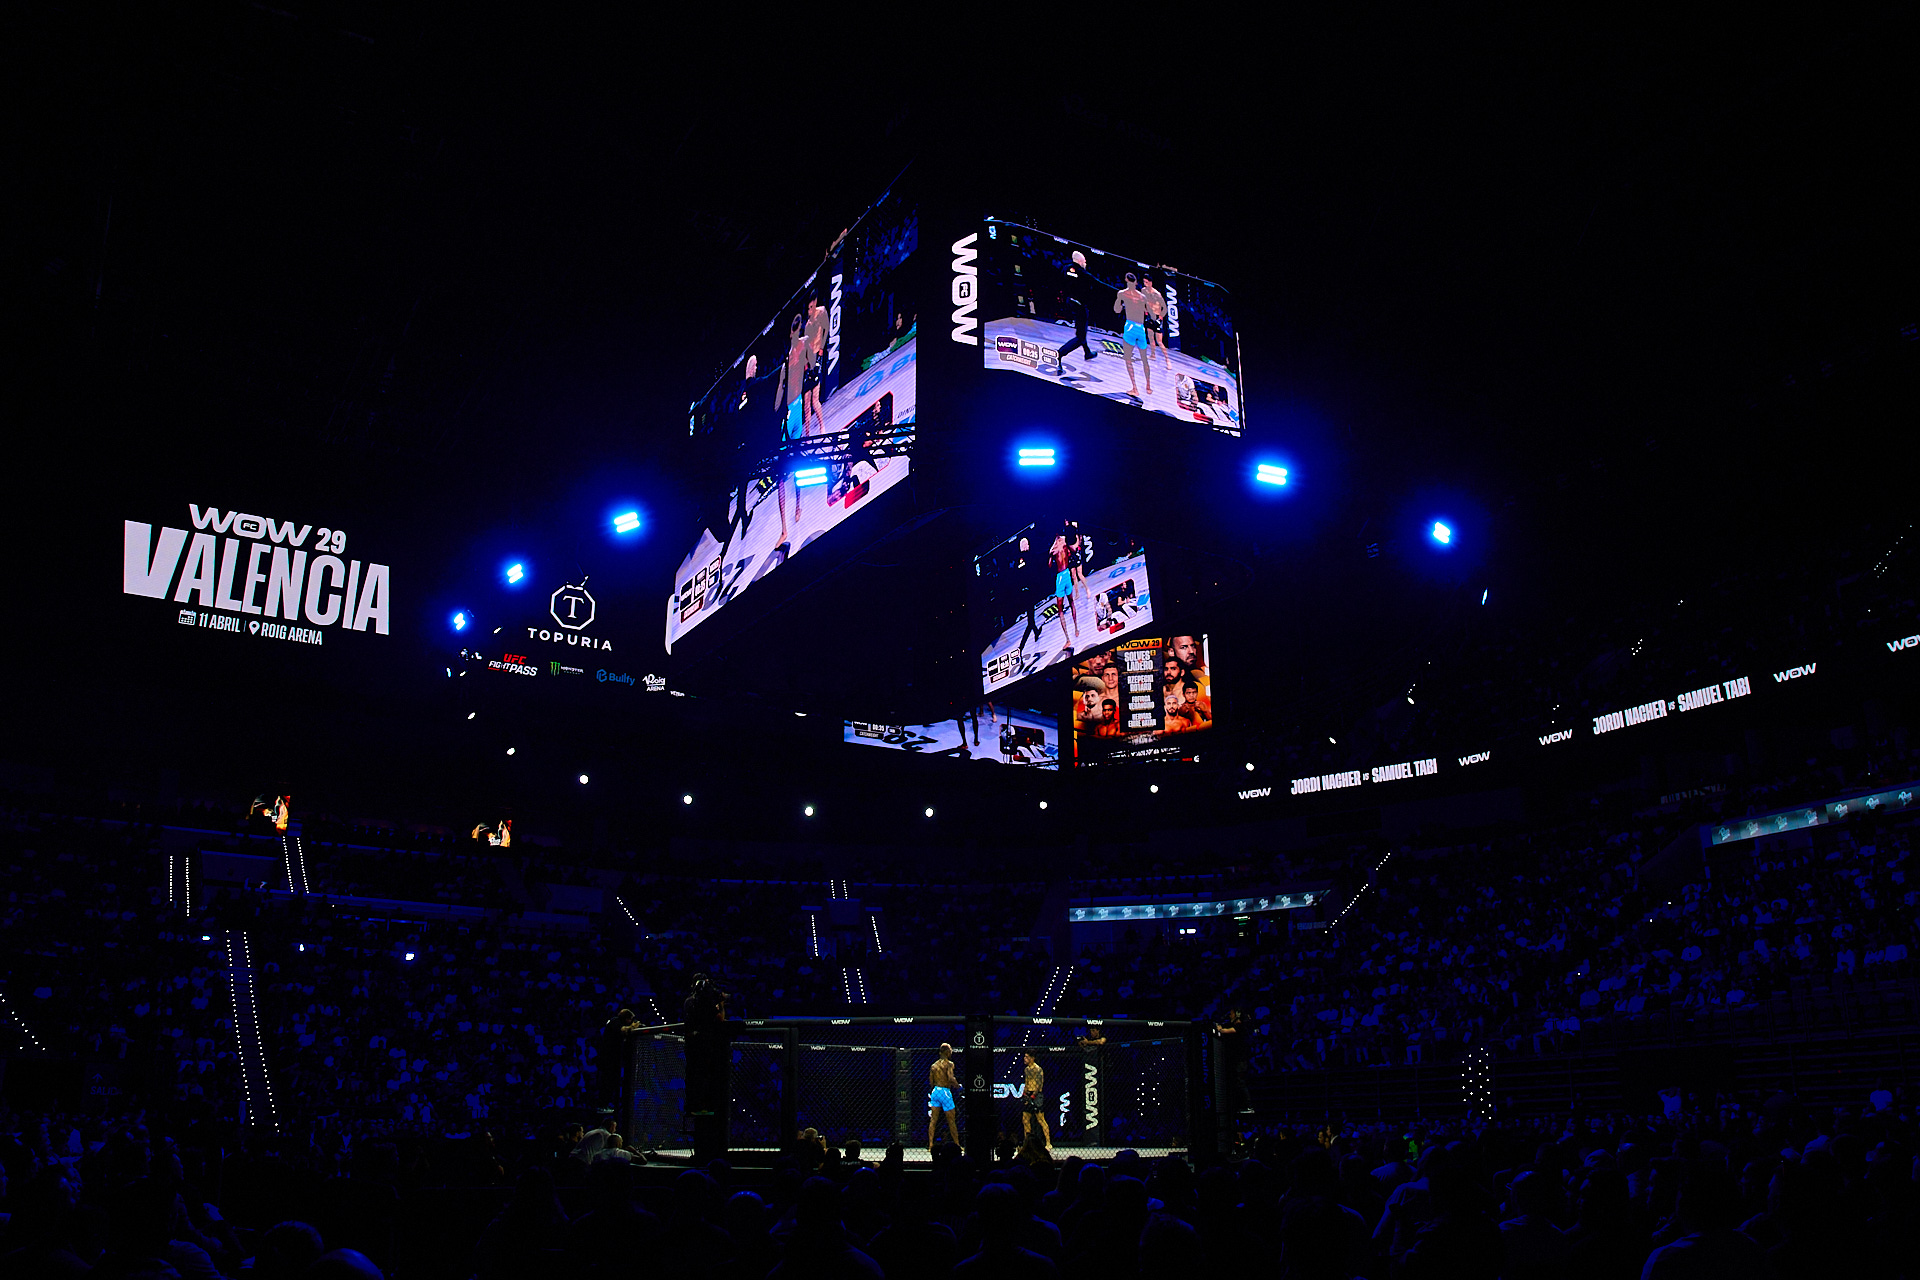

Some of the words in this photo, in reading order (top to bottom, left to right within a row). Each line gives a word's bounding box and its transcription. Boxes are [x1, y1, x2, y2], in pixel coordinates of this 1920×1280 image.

[952, 232, 978, 346] WOW
[1165, 284, 1180, 338] WOW
[828, 274, 843, 375] WOW
[188, 503, 313, 547] WOW
[315, 527, 347, 554] 29
[123, 519, 390, 636] VALENCIA
[199, 612, 209, 628] 11
[208, 613, 241, 633] ABRIL
[260, 621, 288, 640] ROIG
[287, 625, 323, 646] ARENA
[527, 627, 613, 652] TOPURIA
[1886, 634, 1920, 652] WO
[503, 653, 527, 665] UFC
[1124, 650, 1151, 662] SOLVES
[608, 672, 636, 687] Bullfy
[1773, 662, 1817, 683] WOW
[1593, 711, 1625, 735] JORDI
[1624, 699, 1668, 727] NACHER
[1677, 684, 1724, 713] SAMUEL
[1722, 676, 1751, 700] TABI
[1538, 728, 1573, 746] WOW
[1457, 750, 1491, 767] WOW
[1290, 775, 1321, 796] JORDI
[1321, 770, 1362, 791] NACHER
[1371, 761, 1414, 784] SAMUEL
[1413, 757, 1438, 777] TABI
[1237, 787, 1272, 800] WOW
[1084, 1063, 1099, 1131] WOW
